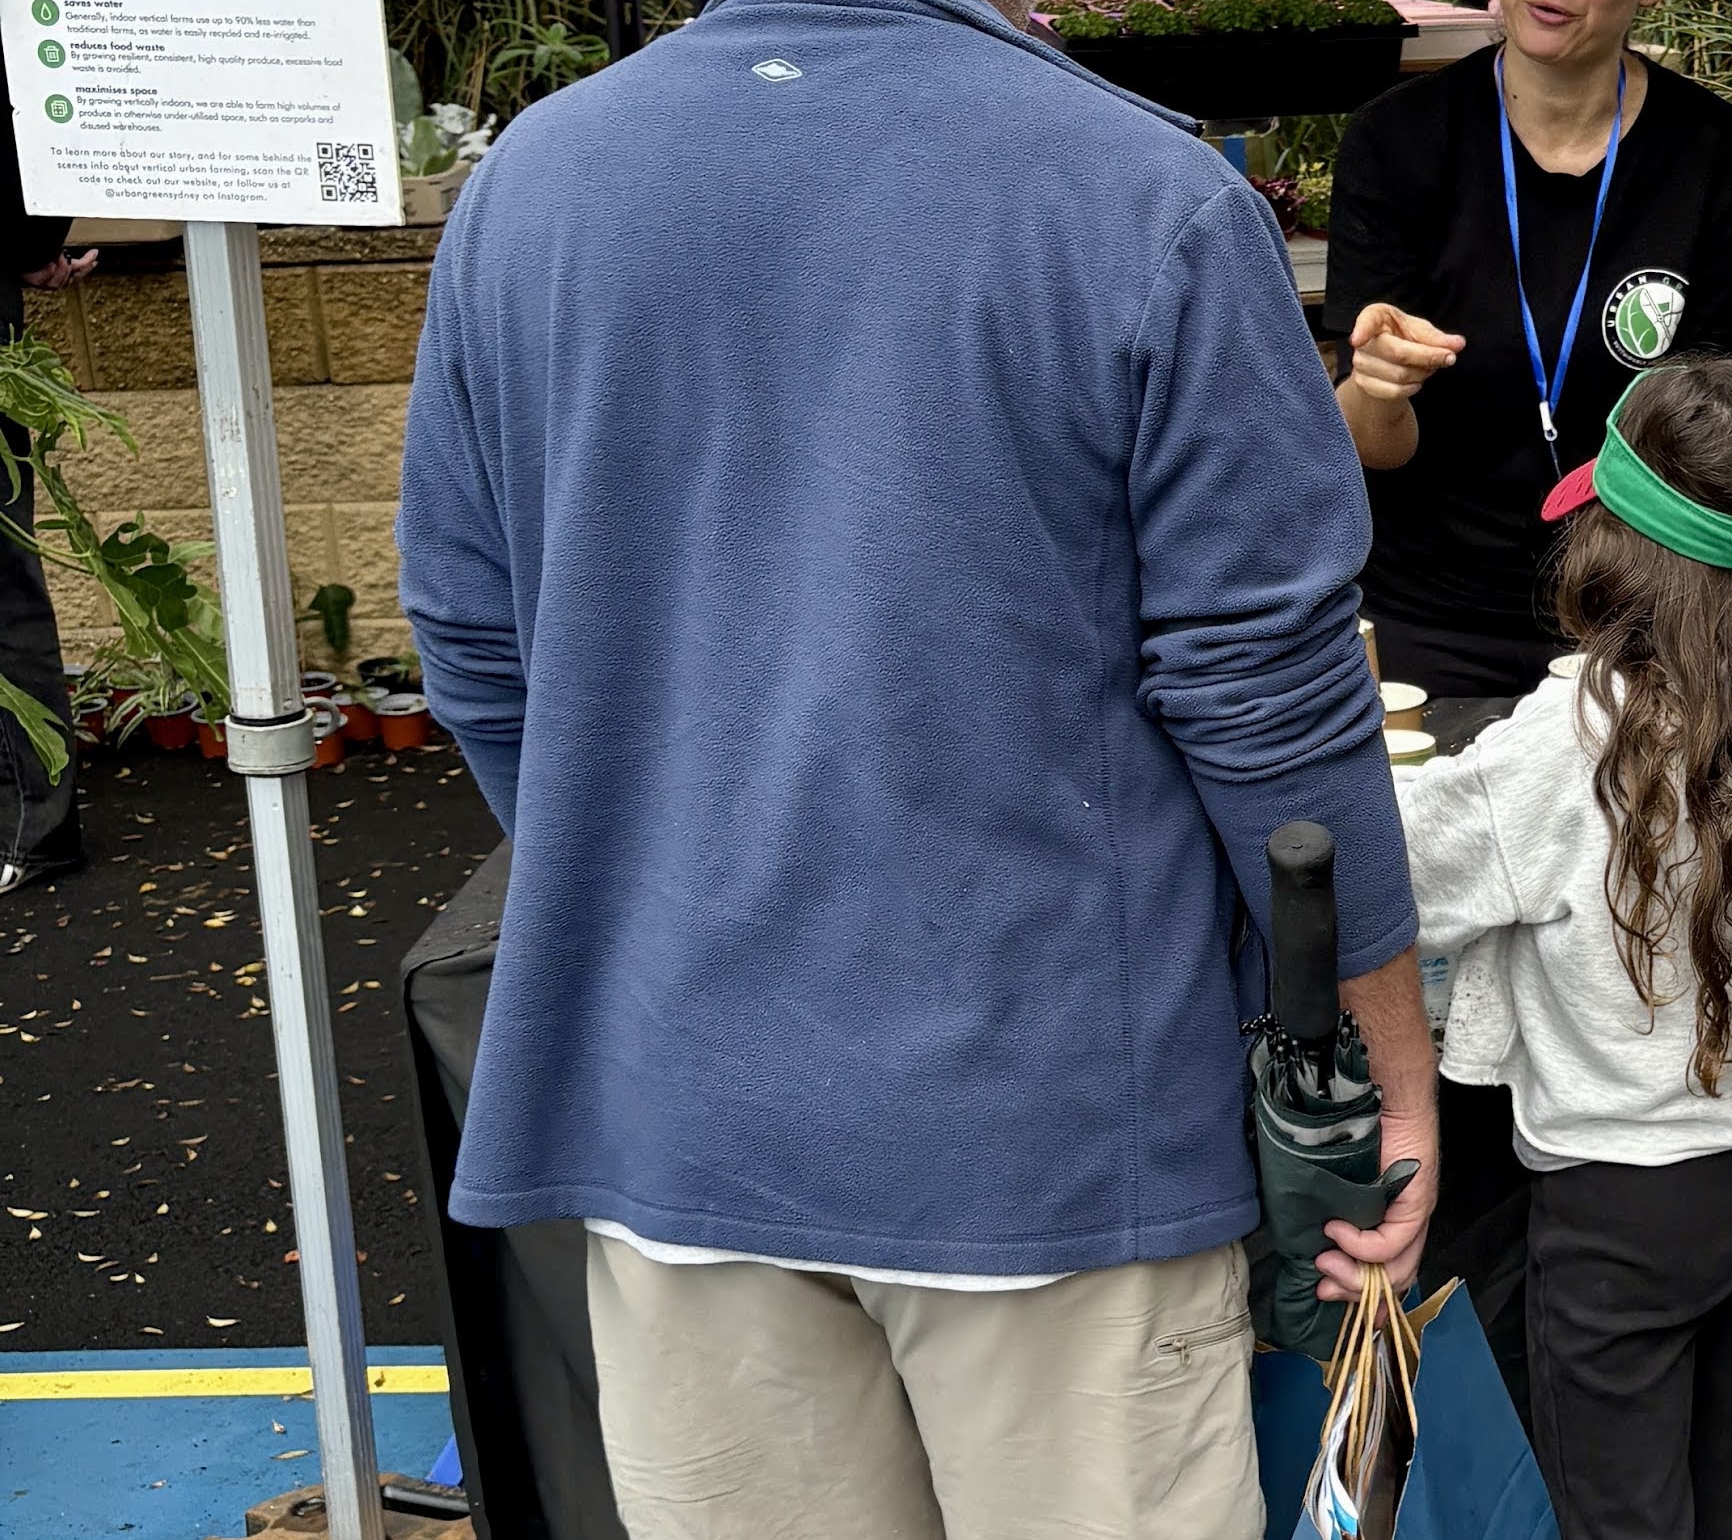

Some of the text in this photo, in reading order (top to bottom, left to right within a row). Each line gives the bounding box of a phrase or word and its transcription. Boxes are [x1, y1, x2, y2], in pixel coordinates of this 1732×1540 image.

[93, 0, 123, 8] water
[70, 40, 107, 50] reduces
[109, 41, 133, 51] food
[75, 85, 157, 96] maximises space
[50, 146, 62, 155] To
[64, 146, 90, 156] learn
[119, 148, 146, 158] about
[197, 152, 215, 160] and
[218, 151, 231, 160] for
[262, 152, 294, 162] behind
[297, 154, 312, 162] the
[90, 161, 109, 170] info
[111, 161, 139, 172] about
[142, 163, 176, 172] vertical
[179, 164, 207, 173] urban
[276, 167, 291, 175] the
[294, 167, 309, 176] QR
[78, 174, 101, 185] code
[103, 176, 114, 184] to
[116, 175, 142, 184] check
[145, 177, 161, 185] out
[236, 178, 265, 188] follow
[105, 188, 199, 201] @urbangreensydney
